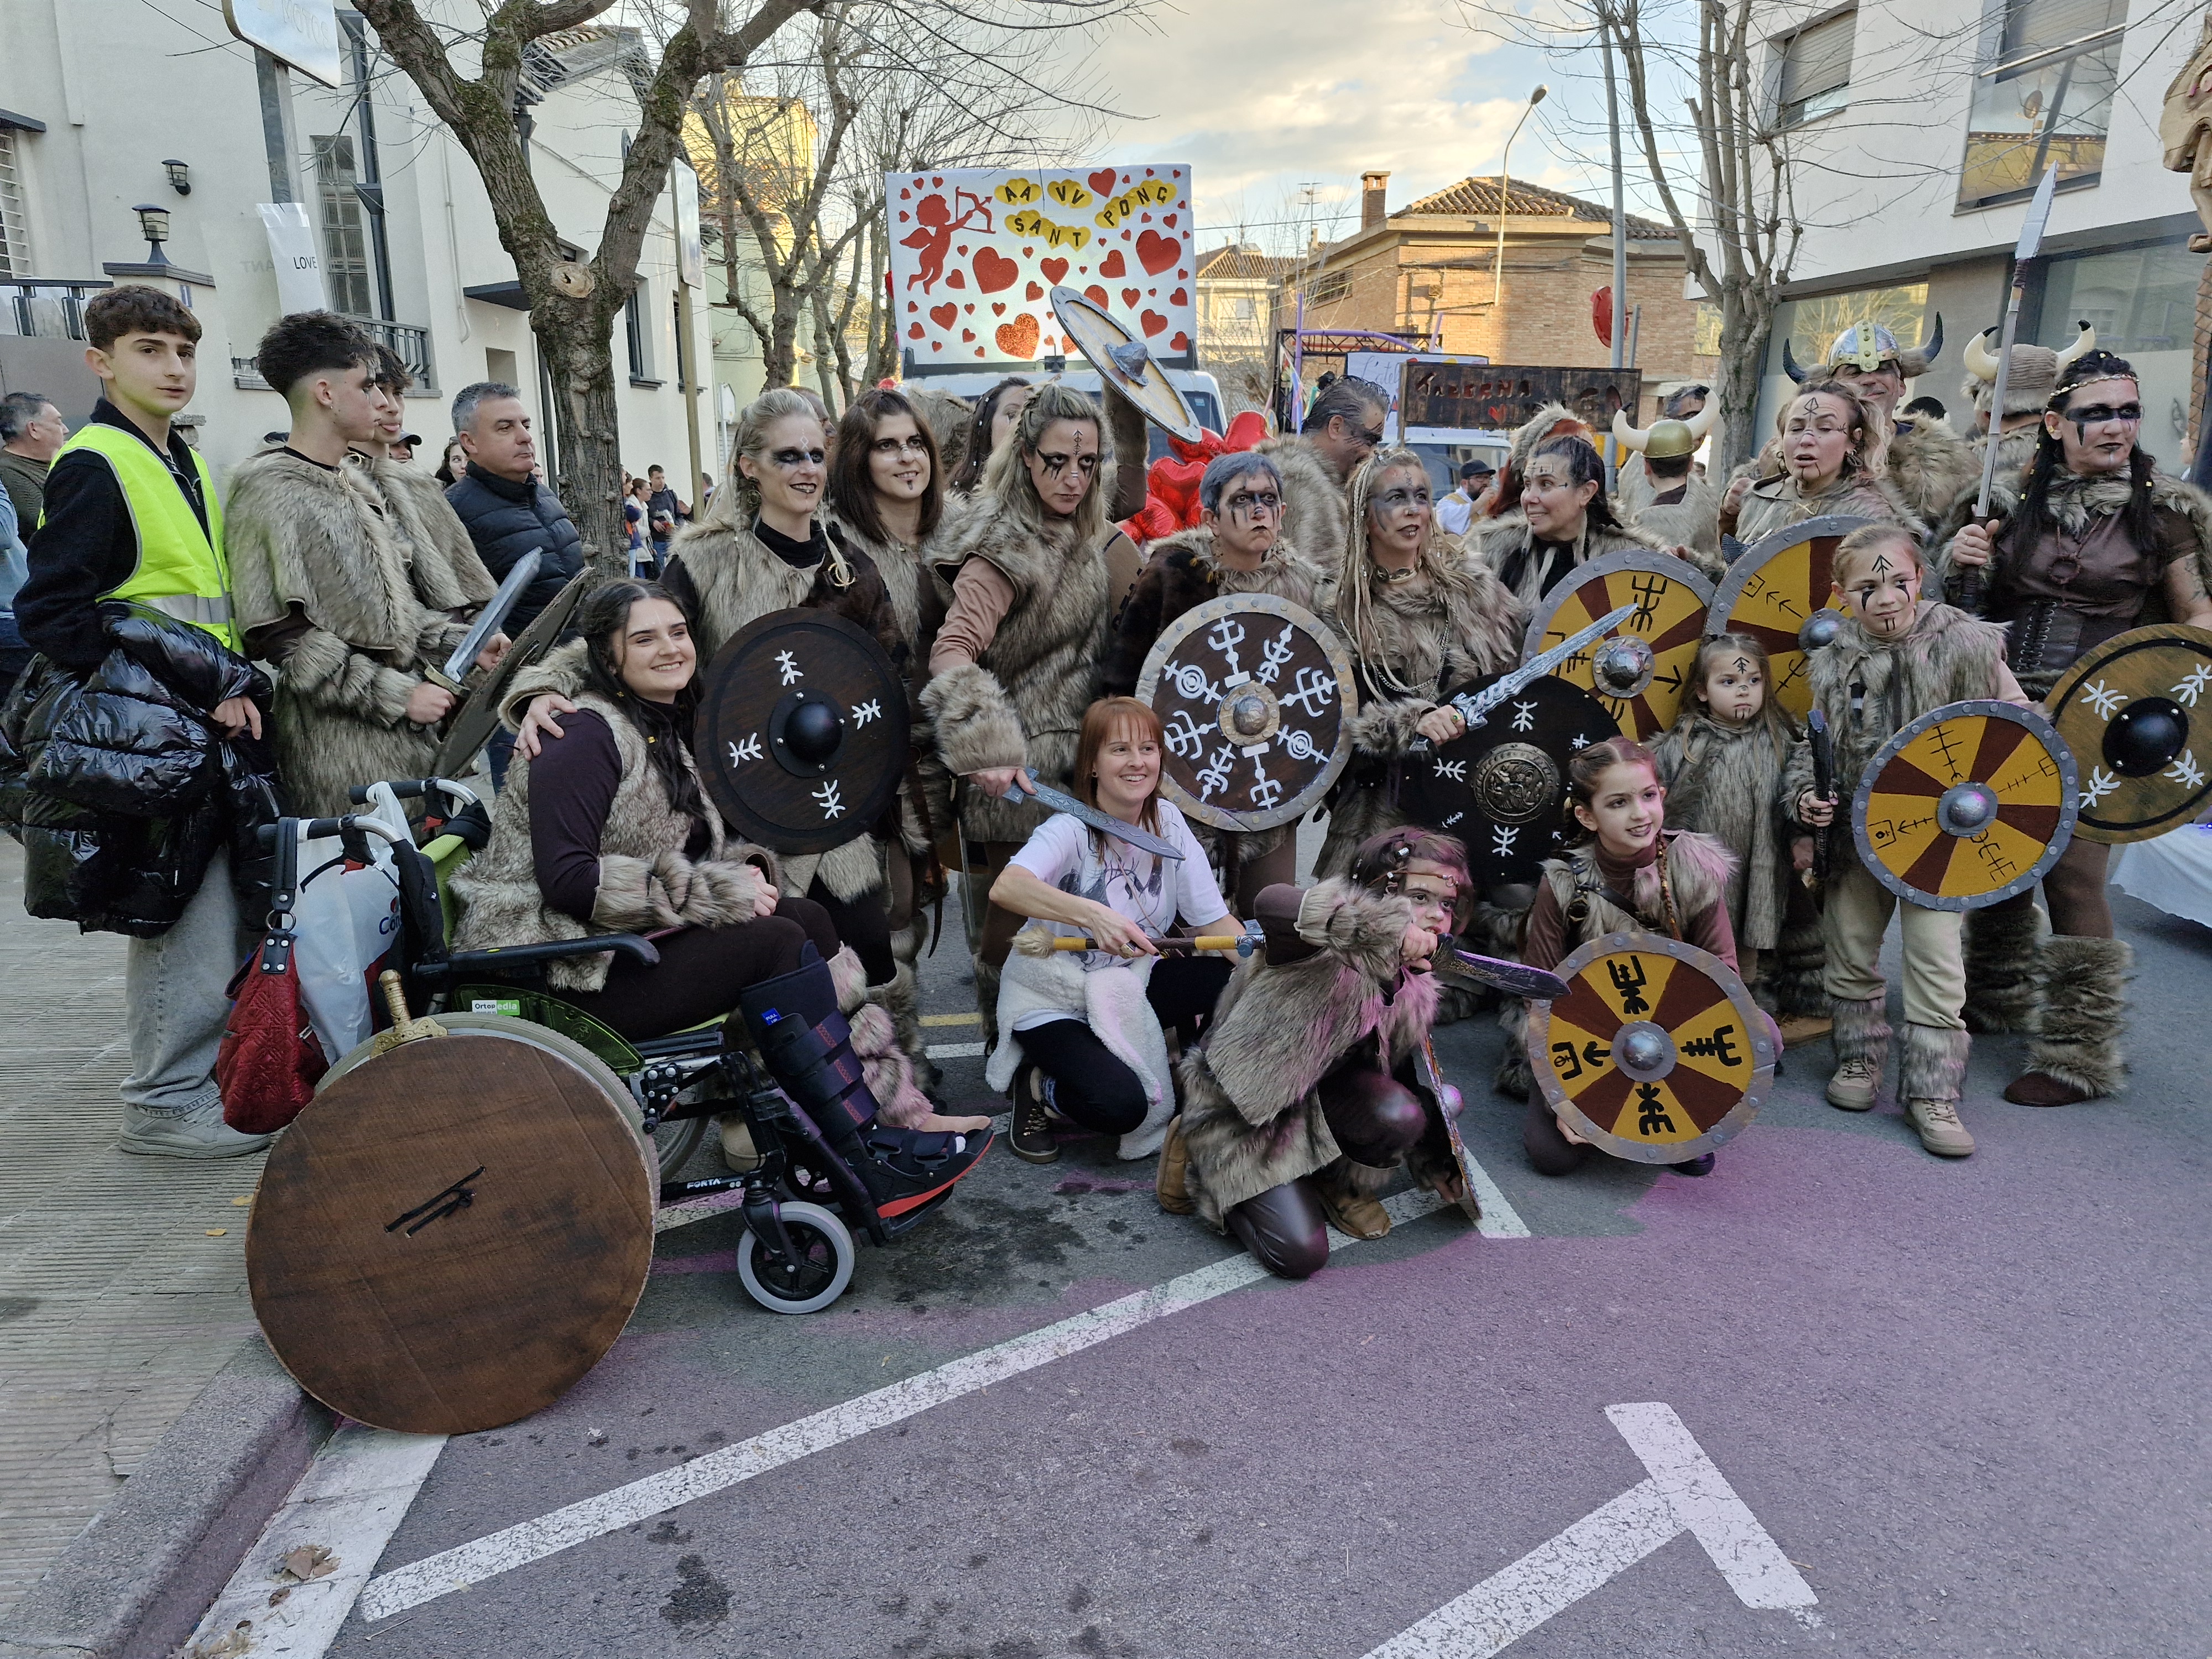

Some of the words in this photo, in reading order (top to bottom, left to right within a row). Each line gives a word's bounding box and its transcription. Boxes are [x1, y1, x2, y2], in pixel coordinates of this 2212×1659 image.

[1014, 217, 1082, 247] SANT
[1103, 186, 1168, 227] PONÇ
[293, 256, 317, 269] LOVE
[687, 1178, 721, 1189] FORTA
